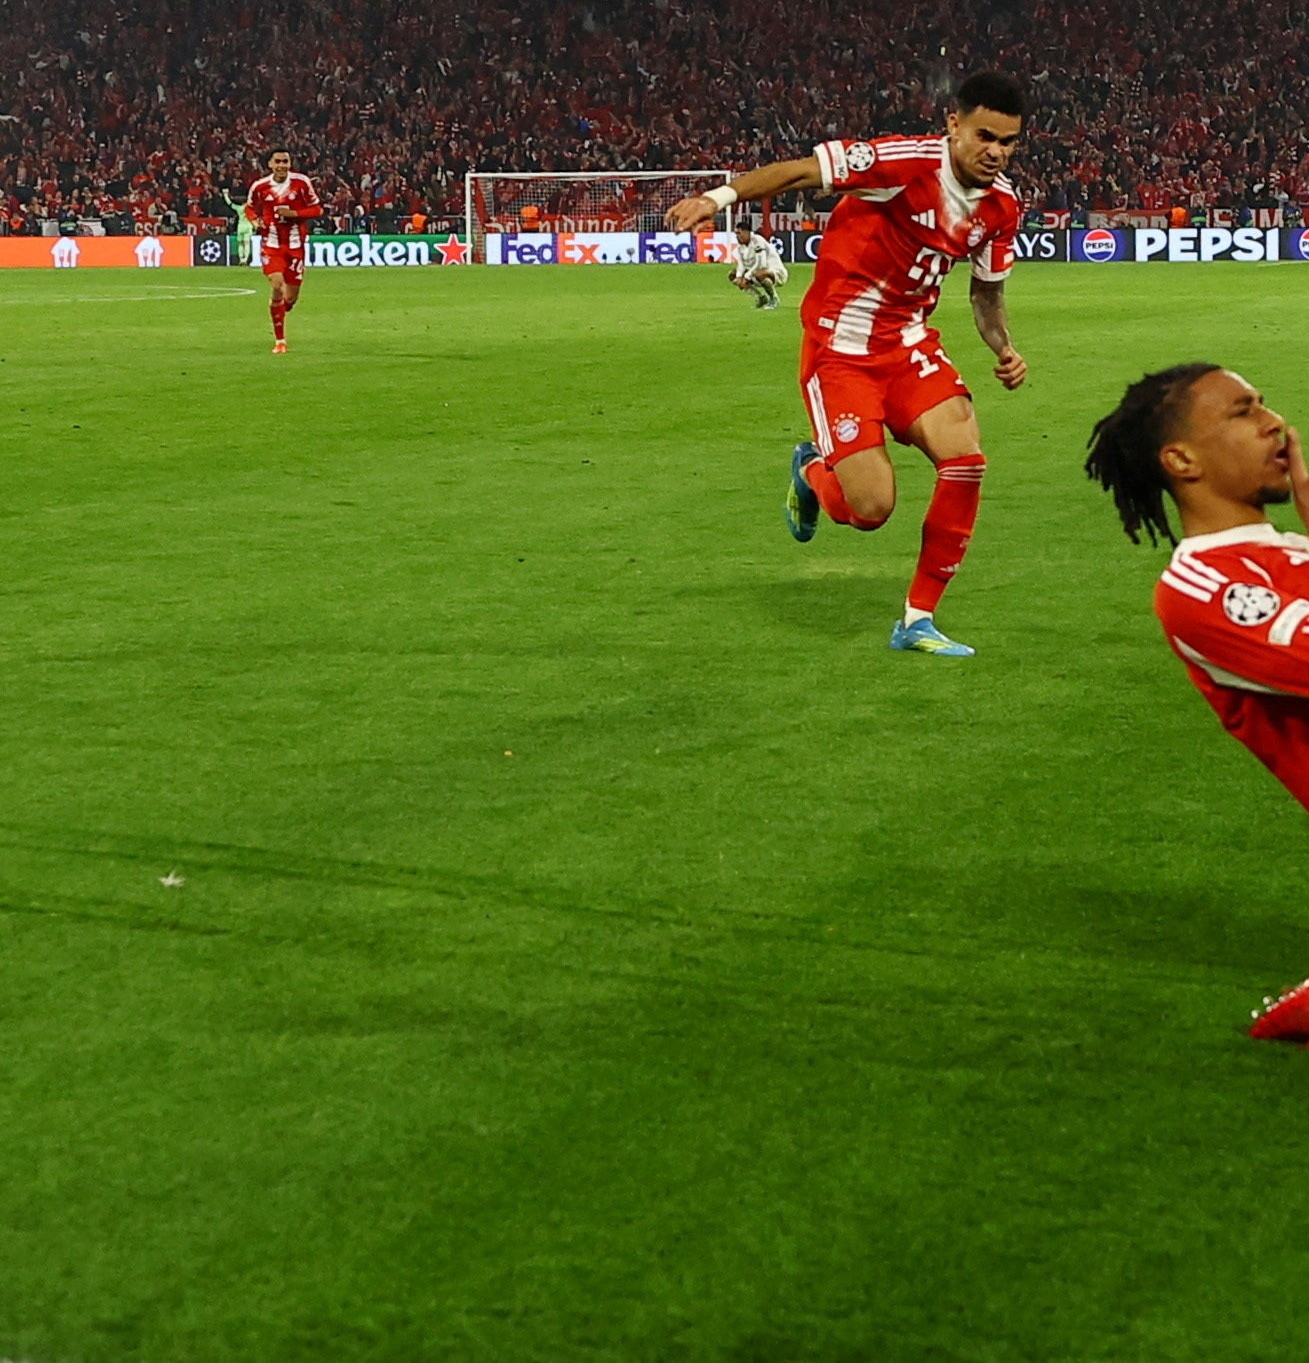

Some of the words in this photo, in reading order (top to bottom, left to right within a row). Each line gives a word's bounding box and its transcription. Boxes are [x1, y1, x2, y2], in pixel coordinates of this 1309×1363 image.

[501, 233, 603, 266] FedEx
[639, 232, 739, 264] FedEx
[1086, 240, 1113, 249] PEPSI
[1134, 227, 1278, 262] PEPSI
